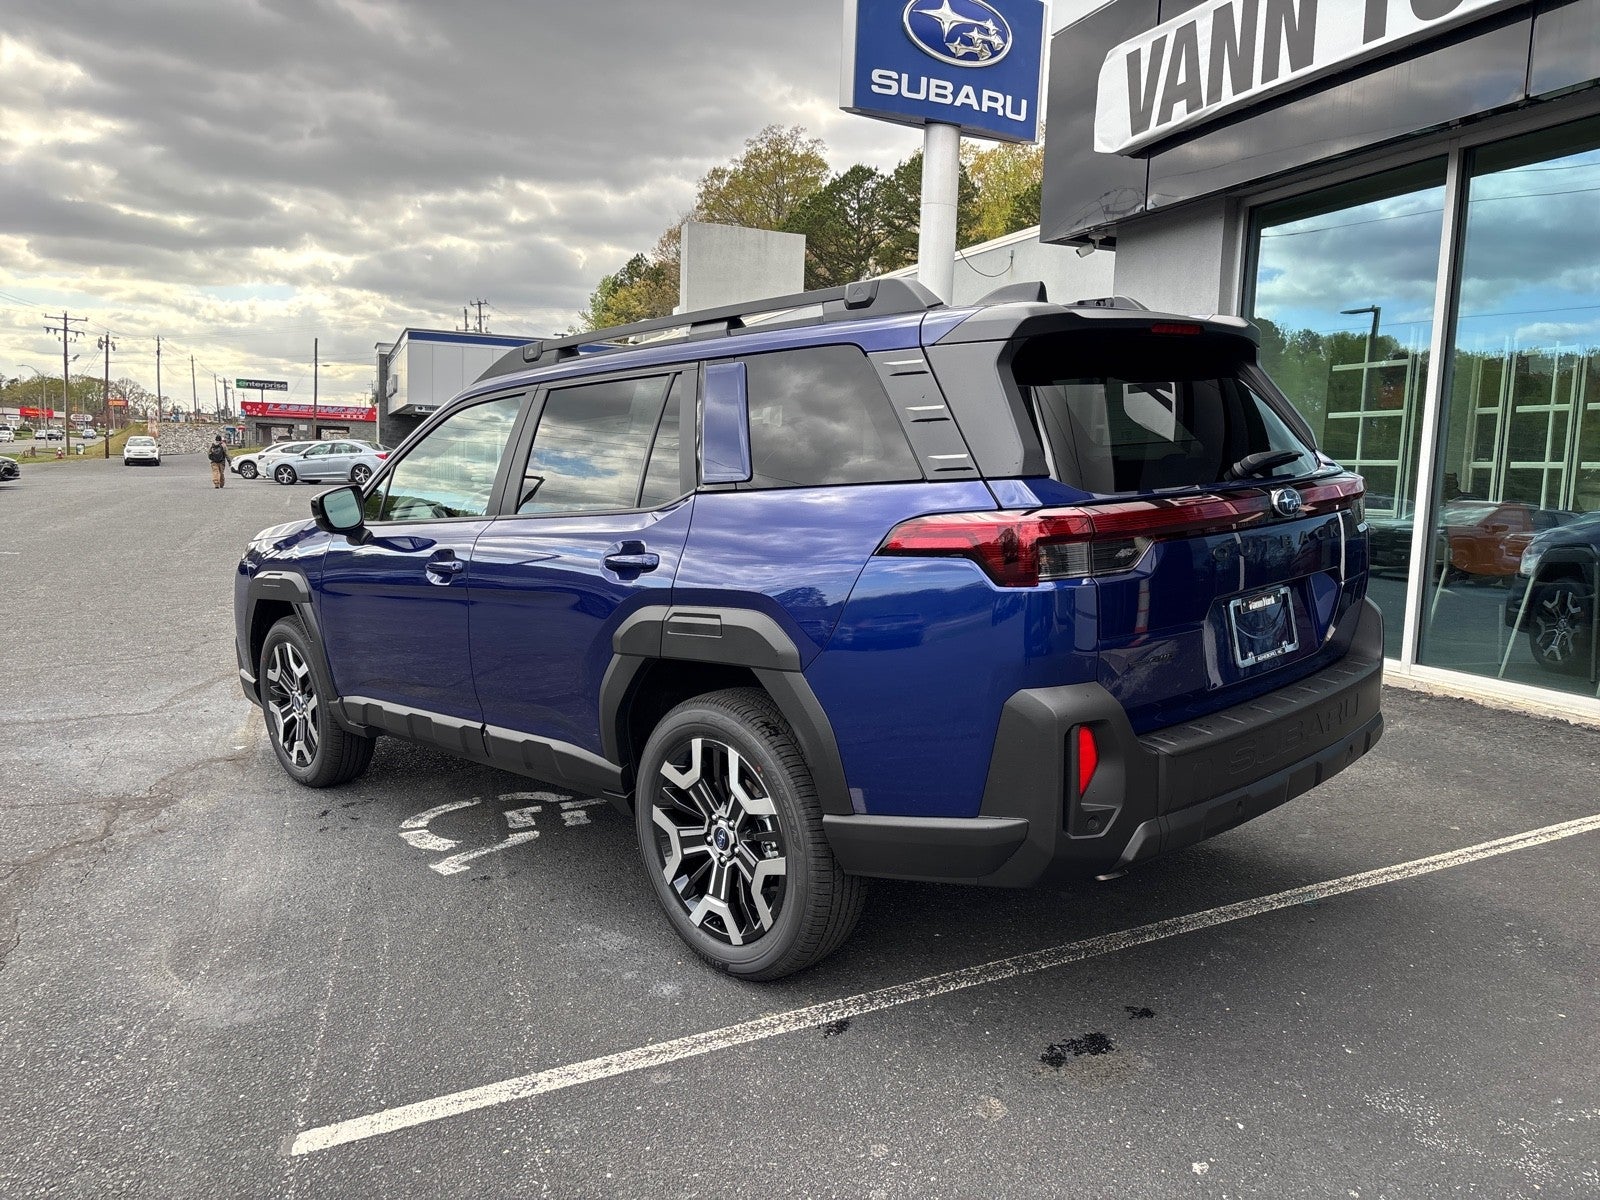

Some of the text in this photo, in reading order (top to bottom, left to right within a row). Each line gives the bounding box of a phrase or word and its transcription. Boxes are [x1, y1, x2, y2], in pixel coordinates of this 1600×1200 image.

[870, 68, 1028, 122] SUBARU
[1126, 0, 1318, 137] VANN
[238, 381, 287, 389] enterprise
[1212, 523, 1338, 562] OUTBACK
[1228, 692, 1359, 775] SUBARU
